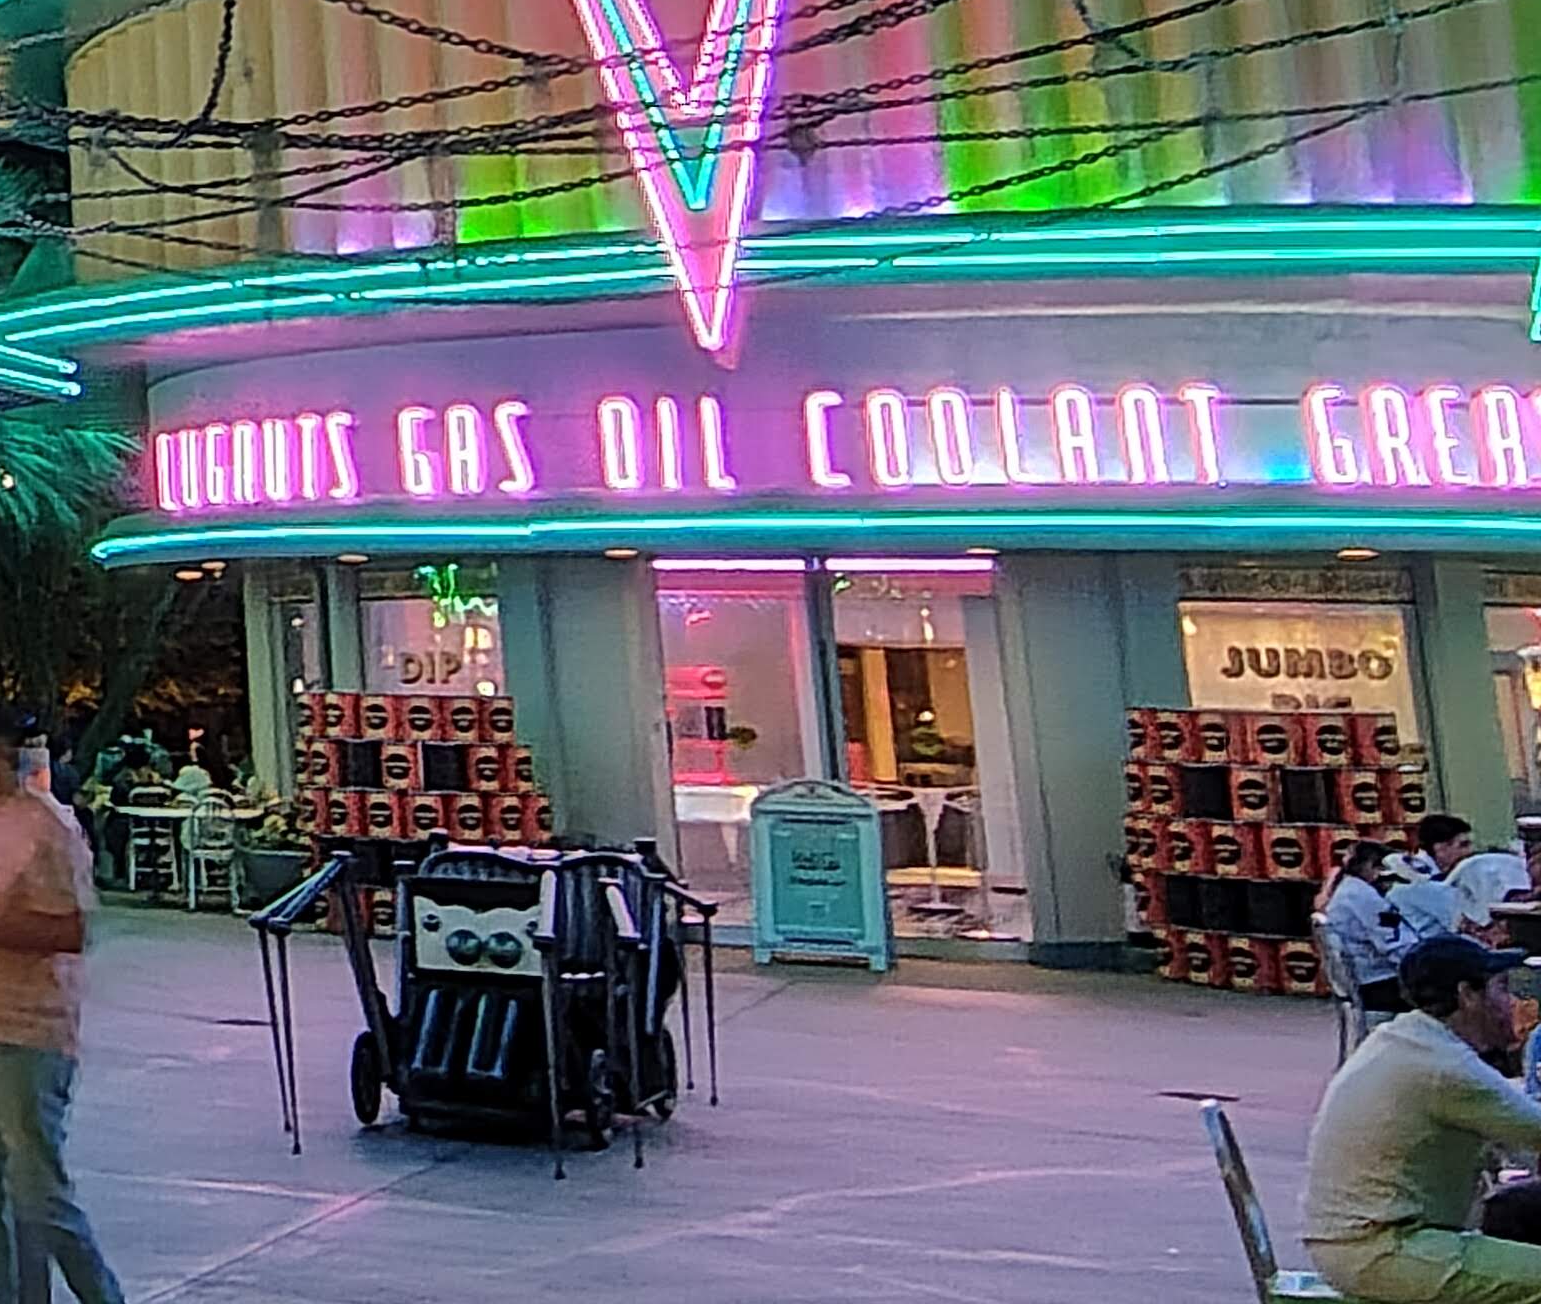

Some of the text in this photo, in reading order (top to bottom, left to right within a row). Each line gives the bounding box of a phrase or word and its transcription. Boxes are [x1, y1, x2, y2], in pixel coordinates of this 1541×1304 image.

[154, 382, 1541, 514] LUGNUTS GAS OIL COOLANT GREA
[400, 650, 463, 685] DIP
[1220, 644, 1394, 681] JUMBO
